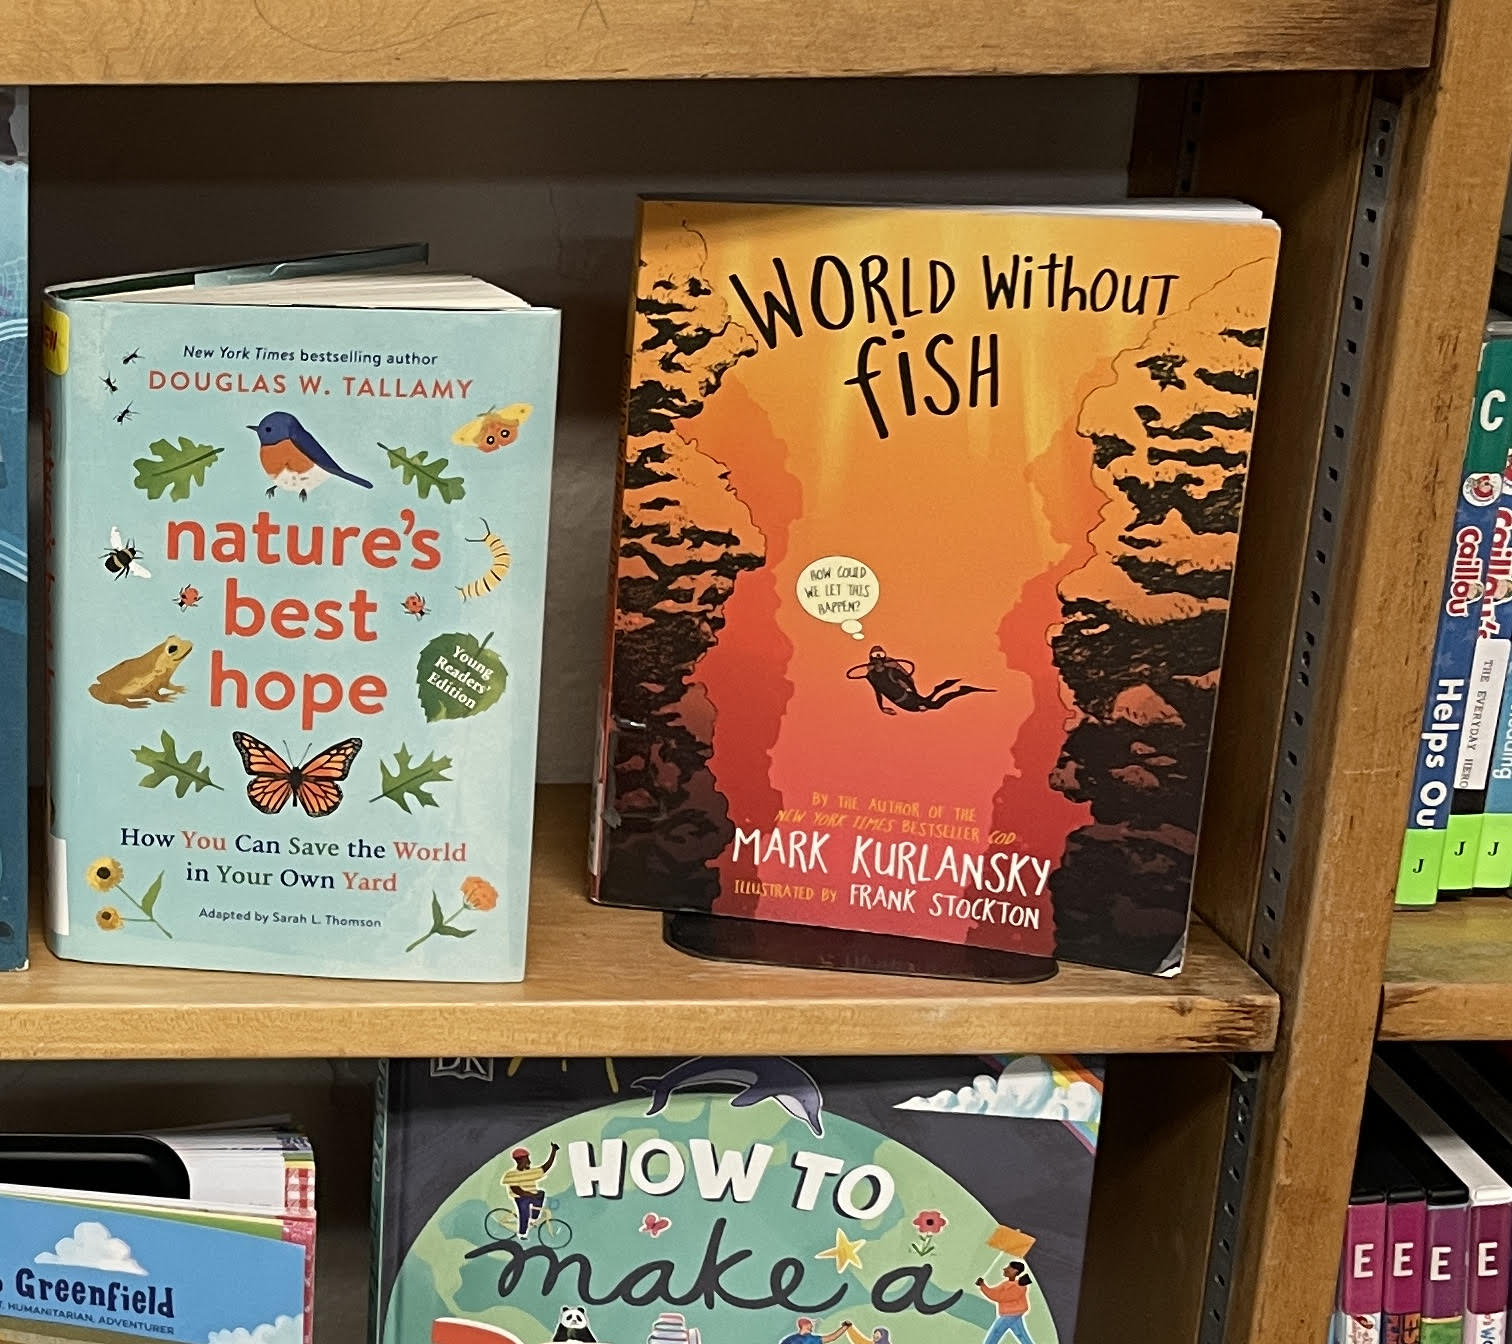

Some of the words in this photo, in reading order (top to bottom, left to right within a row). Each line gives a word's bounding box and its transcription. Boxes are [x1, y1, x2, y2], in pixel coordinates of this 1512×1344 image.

[728, 253, 956, 350] WORLD
[148, 370, 286, 395] DOUGLAS
[299, 376, 330, 396] W.
[342, 376, 474, 399] TALLAMY
[183, 345, 214, 360] New
[219, 346, 250, 361] York
[254, 347, 295, 362] Times
[300, 349, 381, 367] bestselling
[386, 352, 437, 366] author
[167, 509, 441, 571] nature's
[224, 577, 378, 642] best
[210, 650, 388, 732] hope
[1480, 659, 1493, 682] THE
[1421, 679, 1464, 769] Helps
[1468, 691, 1487, 751] EVERYDAY
[732, 827, 830, 874] MARK
[851, 834, 1051, 898] KURLANSKY
[199, 908, 252, 924] Adapted
[255, 912, 269, 925] by
[272, 912, 308, 924] Sarah
[325, 915, 382, 928] Thomson
[734, 879, 814, 900] ILLUSTRATED
[820, 886, 838, 903] BY
[849, 883, 916, 914] FRANK
[928, 892, 1040, 931] STOCKTON
[567, 1138, 774, 1204] HOW
[791, 1151, 895, 1220] TO
[16, 1267, 175, 1320] Greenfield
[463, 1217, 849, 1313] make
[870, 1263, 964, 1314] a
